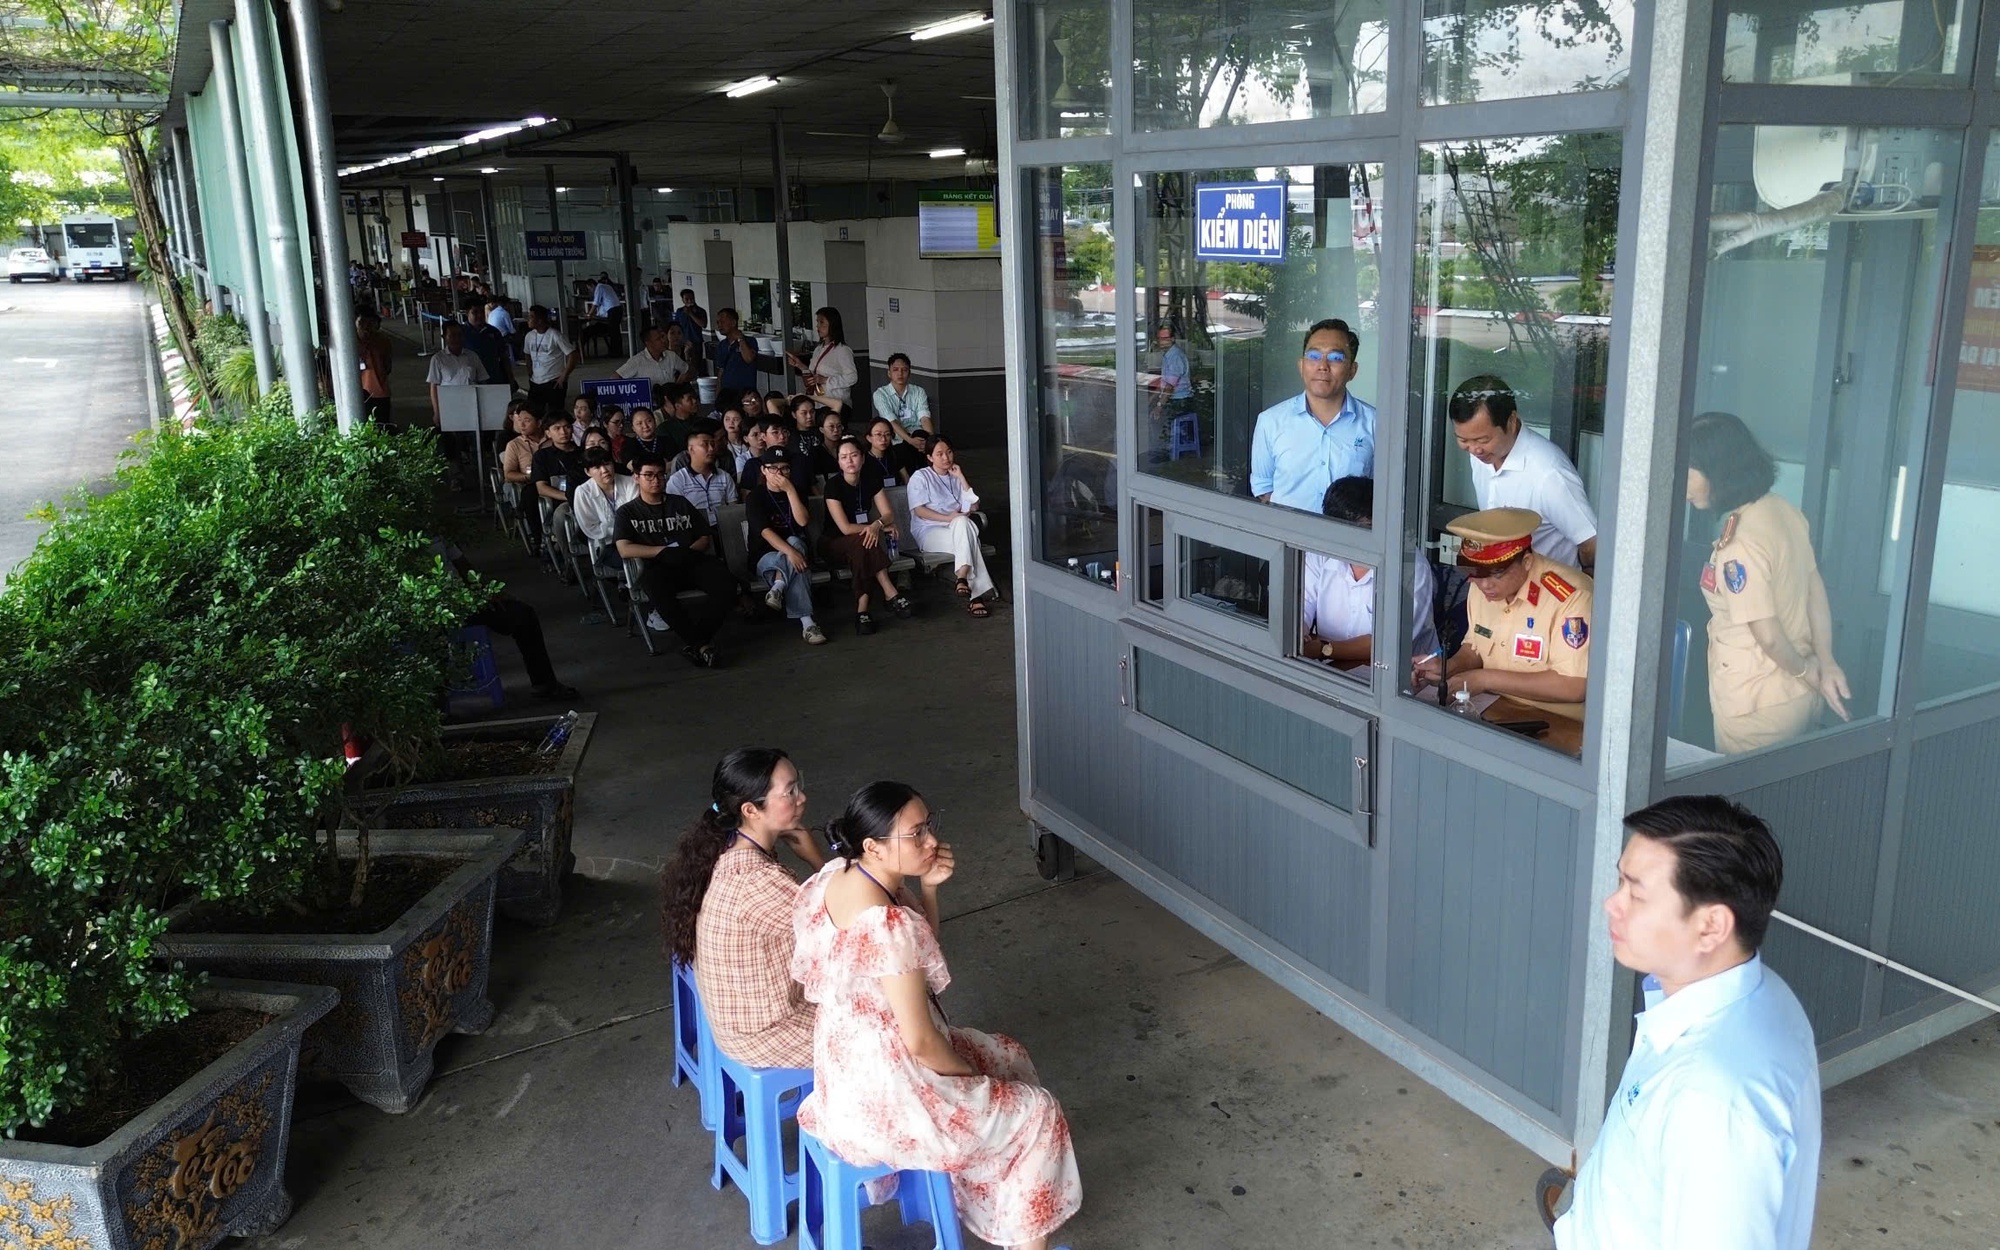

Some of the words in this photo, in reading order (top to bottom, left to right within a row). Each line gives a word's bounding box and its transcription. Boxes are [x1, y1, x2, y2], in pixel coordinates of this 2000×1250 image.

[1225, 189, 1255, 209] PHÒNG
[1201, 207, 1239, 249] KIỂM
[1243, 212, 1280, 255] DIỆN
[597, 385, 616, 396] KHU
[618, 383, 637, 396] VỰC
